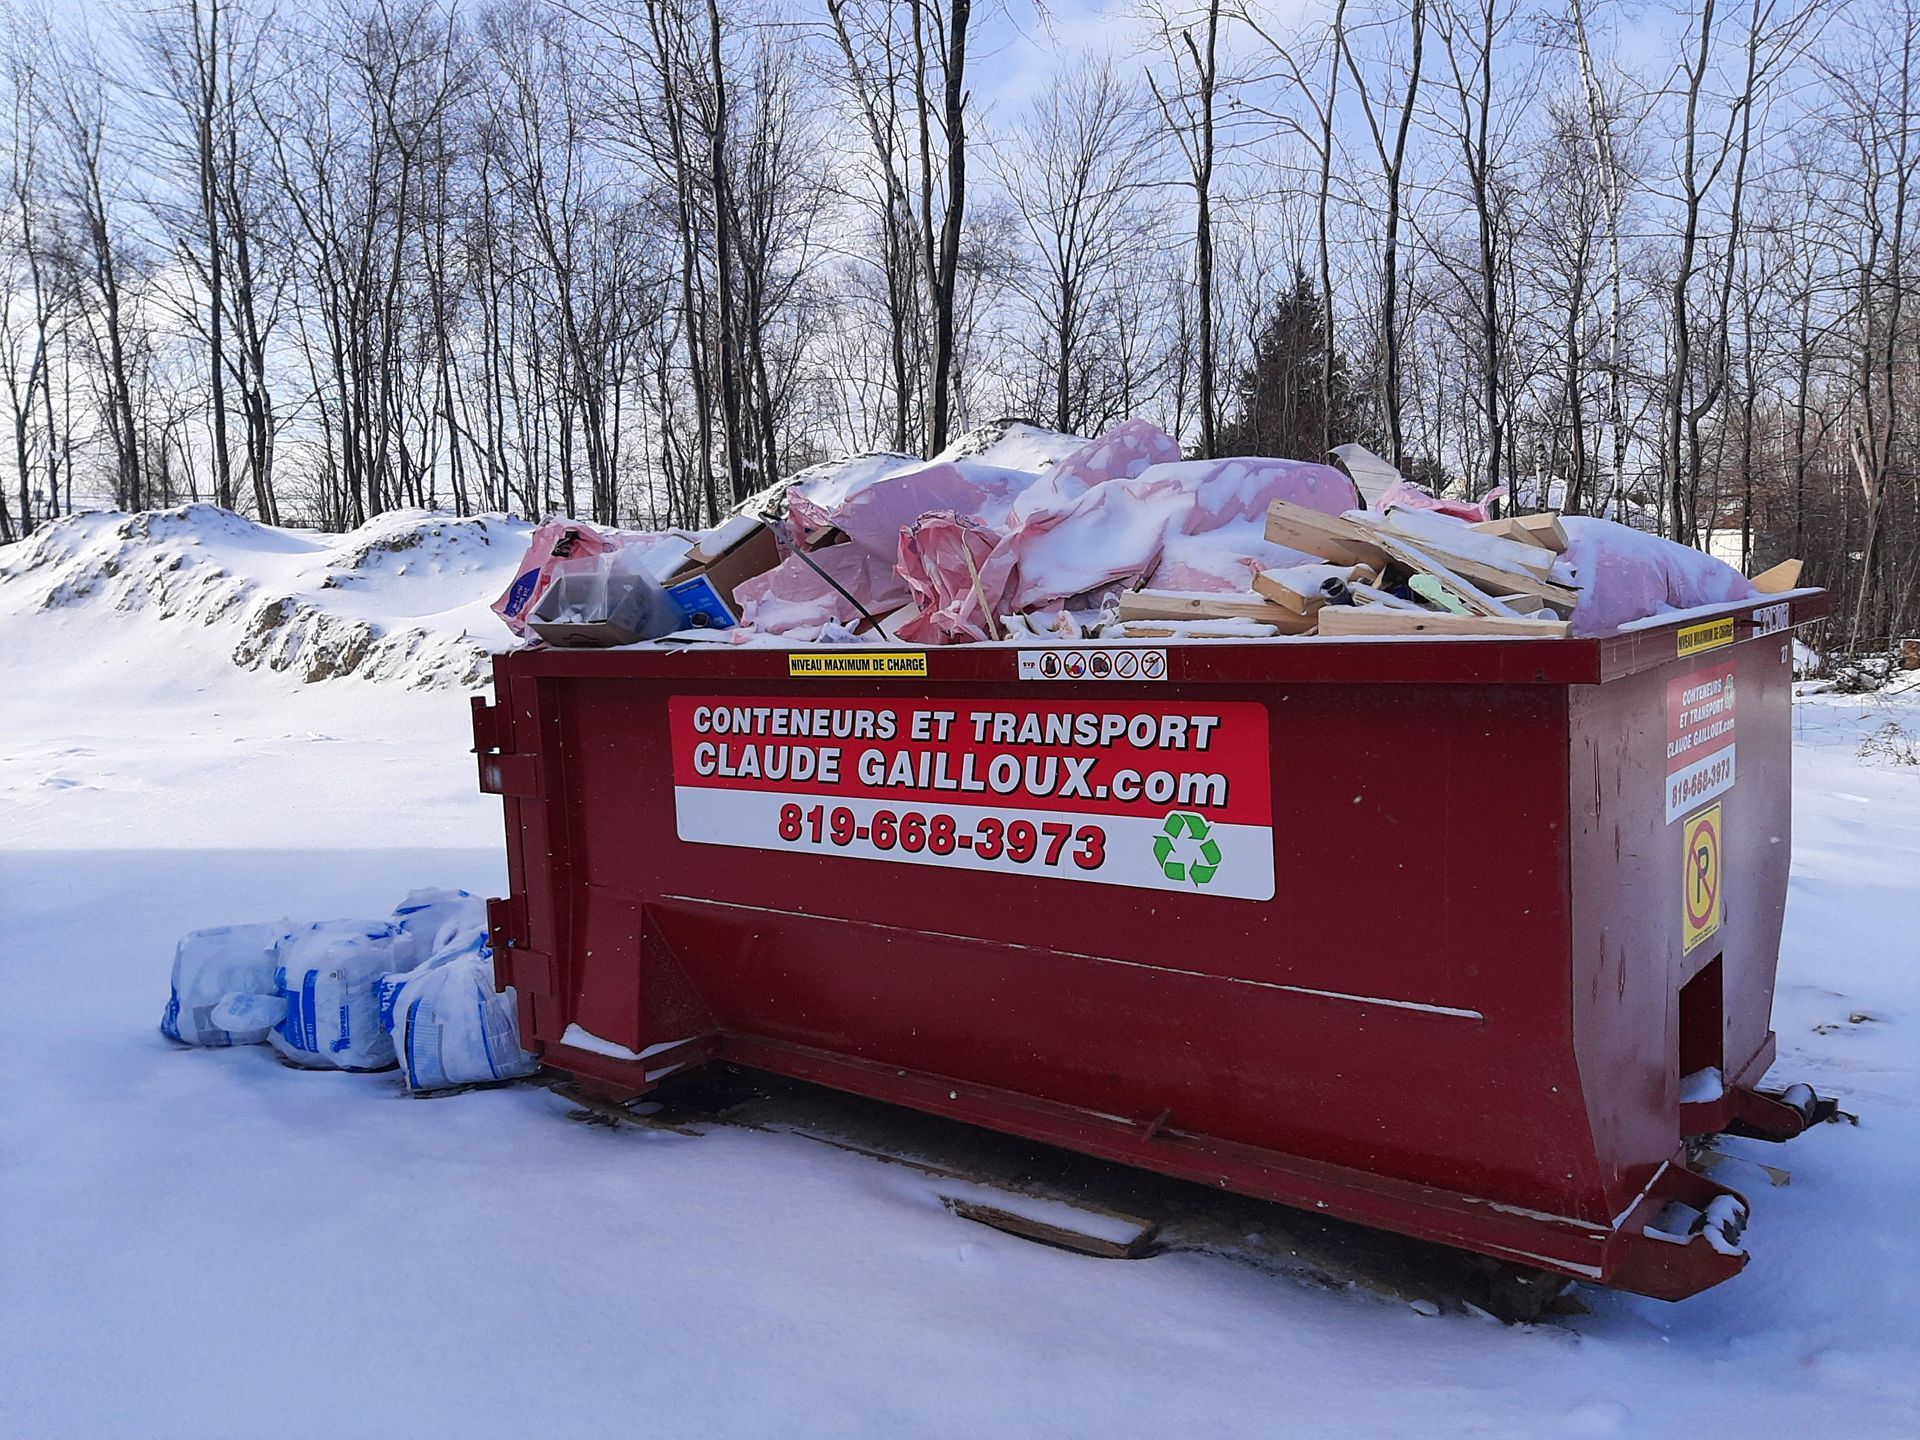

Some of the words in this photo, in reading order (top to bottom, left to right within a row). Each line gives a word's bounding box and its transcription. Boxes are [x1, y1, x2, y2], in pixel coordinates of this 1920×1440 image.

[791, 658, 822, 671] NIVEAU
[824, 658, 870, 671] MAXIMUM
[873, 658, 885, 671] DE
[887, 658, 925, 671] CHARGE
[1679, 712, 1689, 729] ET
[1690, 698, 1724, 724] TRANSPORT
[1682, 679, 1722, 706] CONTENEURS
[693, 706, 897, 740] CONTENEURS
[911, 710, 955, 742] ET
[970, 712, 1222, 750] TRANSPORT
[1667, 734, 1692, 759] CLAUDE
[1693, 718, 1735, 747] GAILLOUX.com
[693, 741, 842, 784] CLAUDE
[857, 748, 1228, 808] GAILLOUX.com
[1672, 757, 1730, 809] 819-668-3973
[778, 802, 1108, 871] 819-668-3973
[1696, 846, 1709, 904] P
